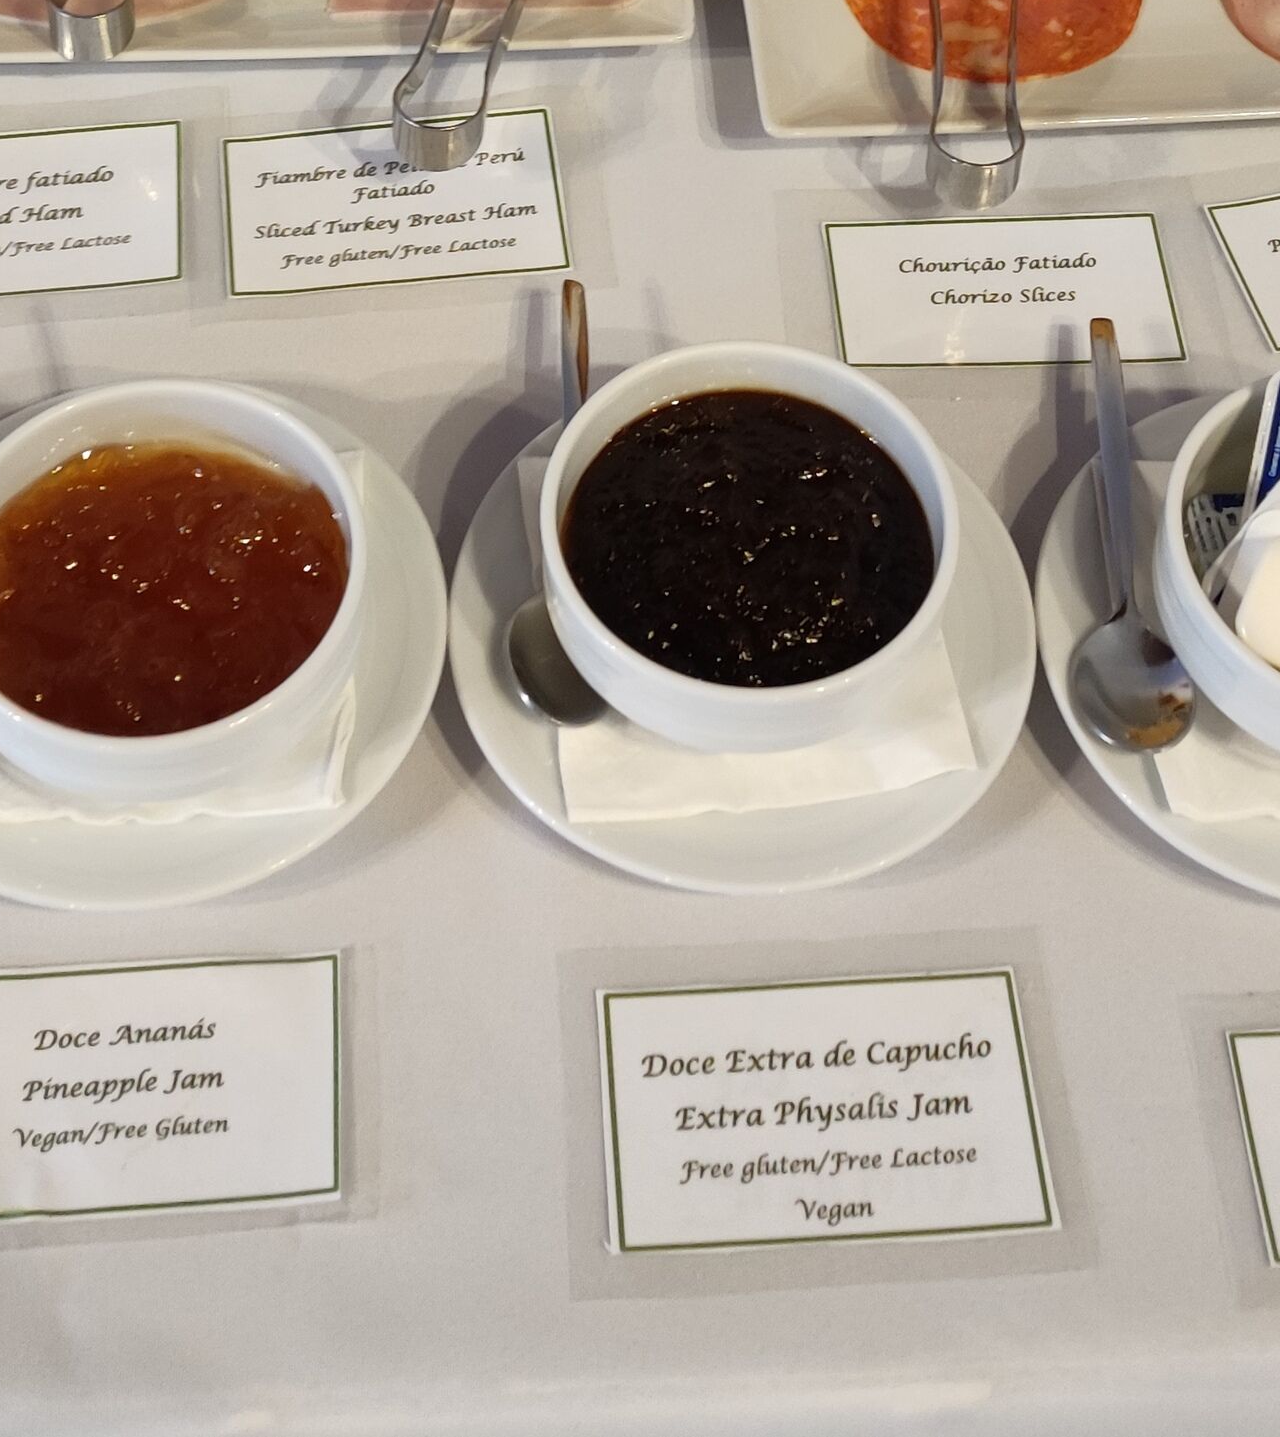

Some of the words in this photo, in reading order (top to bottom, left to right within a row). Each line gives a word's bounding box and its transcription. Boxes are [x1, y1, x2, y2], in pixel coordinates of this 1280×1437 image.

[20, 165, 114, 195] fatiado
[254, 166, 347, 188] Fiambre
[354, 161, 377, 178] de
[474, 147, 525, 166] Perú
[350, 180, 435, 204] Fatiado
[19, 203, 85, 223] Ham
[253, 220, 321, 240] Sliced
[322, 216, 400, 234] Turkey
[407, 208, 476, 227] Breast
[482, 202, 538, 221] Ham
[60, 232, 132, 251] Lactose
[279, 254, 325, 270] Free
[328, 242, 442, 268] gluten/Free
[447, 236, 518, 253] Lactose
[898, 256, 1006, 275] Chourição
[1012, 252, 1097, 274] Fatiado
[930, 288, 1012, 305] Chorizo
[1019, 286, 1076, 303] Slices
[32, 1027, 100, 1052] Doce
[108, 1017, 217, 1046] Ananás
[641, 1052, 716, 1079] Doce
[725, 1047, 815, 1074] Extra
[822, 1038, 857, 1067] de
[866, 1031, 993, 1072] Capucho
[21, 1067, 159, 1104] Pineapple
[163, 1068, 225, 1096] Jam
[674, 1105, 766, 1133] Extra
[773, 1091, 899, 1133] Physalis
[907, 1091, 973, 1122] Jam
[12, 1120, 149, 1153] Vegan/Free
[154, 1114, 229, 1141] Gluten
[679, 1158, 734, 1185] Free
[740, 1149, 884, 1184] gluten/Free
[890, 1144, 978, 1169] Lactose
[795, 1196, 875, 1226] Vegan
